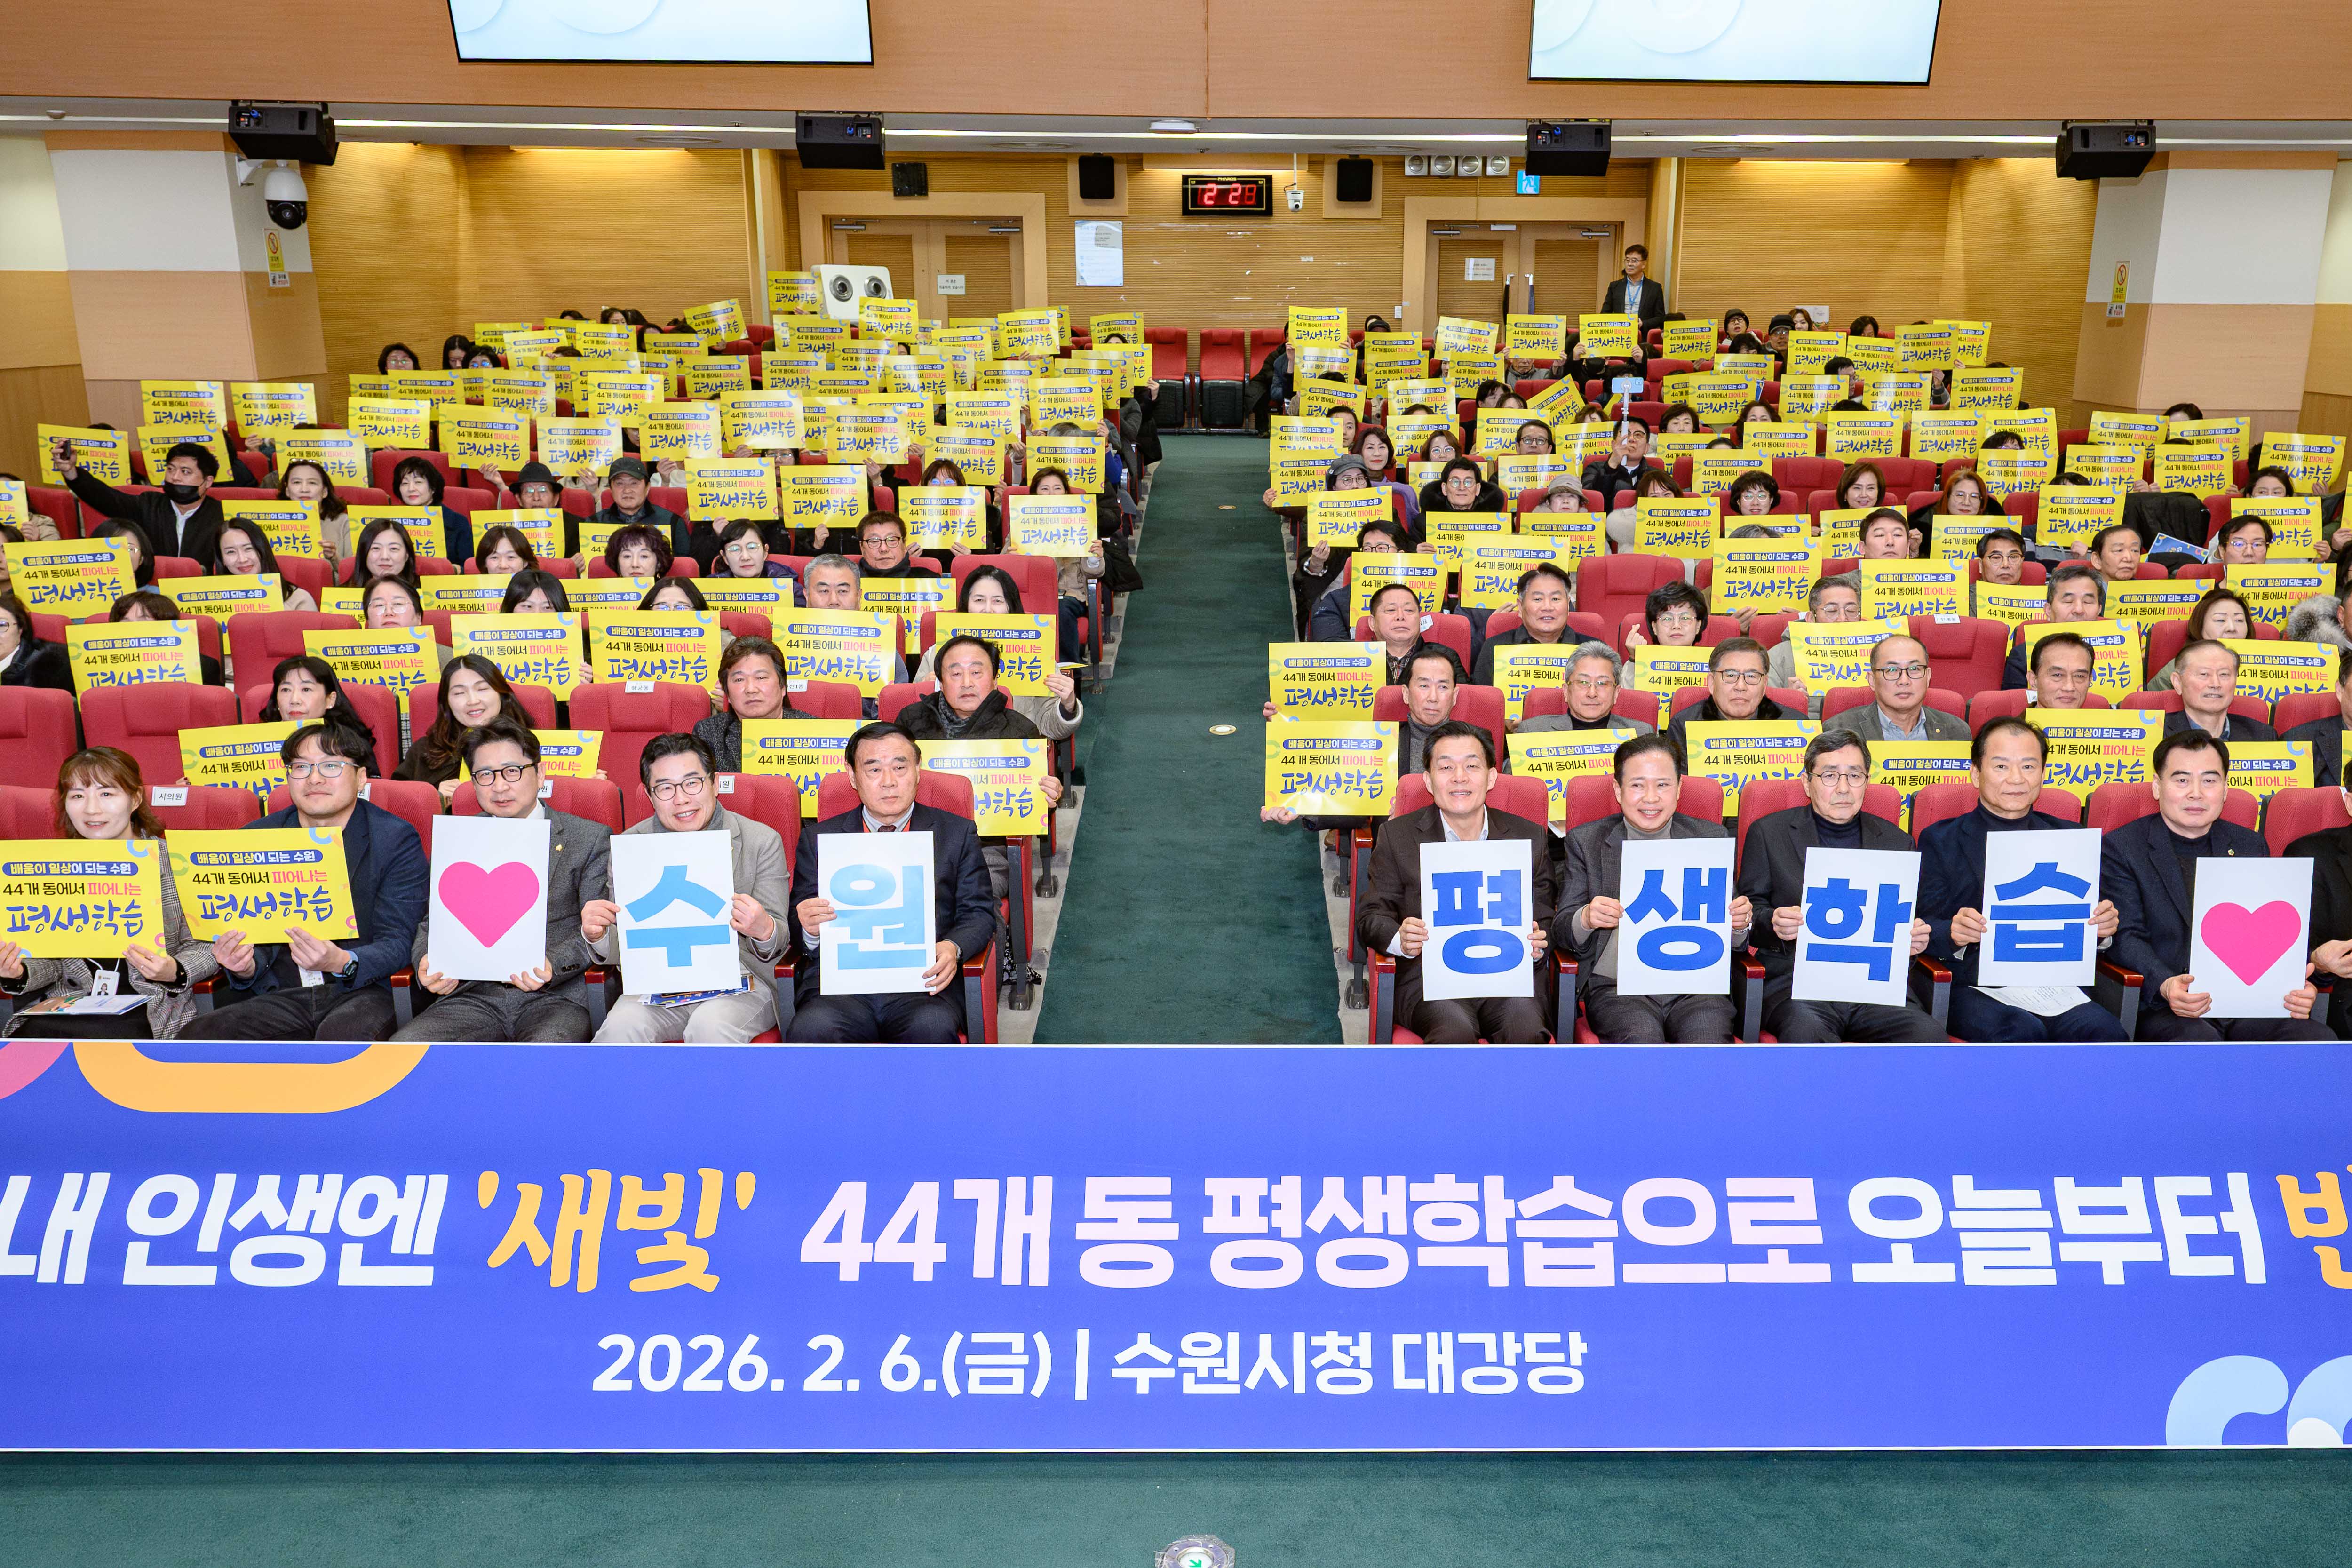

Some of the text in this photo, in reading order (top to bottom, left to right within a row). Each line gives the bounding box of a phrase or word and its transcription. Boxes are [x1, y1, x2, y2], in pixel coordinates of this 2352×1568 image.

[1296, 329, 1340, 341] 평생학습
[1587, 336, 1631, 348] 평생학습
[1513, 338, 1558, 350] 평생학습
[1902, 348, 1950, 362] 평생학습
[1039, 404, 1094, 420] 평생학습
[458, 443, 519, 461] 평생학습
[2165, 472, 2225, 489] 평생학습
[794, 498, 858, 516] 평생학습
[1644, 531, 1709, 548] 평생학습
[25, 566, 119, 579] 44개 동에서 피어나는
[1726, 565, 1810, 574] 44개 동에서 피어나는
[29, 579, 121, 604] 평생학습
[1725, 577, 1808, 600] 평생학습
[1875, 587, 1957, 596] 44개 동에서 피어나는
[612, 627, 699, 637] 배움이 일상이 되는 수원
[793, 624, 875, 637] 배움이 일상이 되는 수원
[606, 642, 707, 653] 44개 동에서 피어나는
[787, 639, 882, 652] 44개 동에서 피어나는
[608, 656, 707, 683] 평생학습
[787, 656, 880, 682] 평생학습
[1284, 672, 1373, 682] 44개 동에서 피어나는
[1285, 684, 1374, 708] 평생학습
[2048, 728, 2140, 738] 배움이 일상이 되는 수원
[1288, 740, 1376, 749] 배움이 일상이 되는 수원
[2068, 744, 2146, 756] 동에서 피어나는
[934, 758, 1025, 768] 배움이 일상이 되는 수원
[1281, 755, 1383, 766] 44개 동에서 피어나는
[991, 774, 1032, 785] 피어나는
[1281, 769, 1383, 799] 평생학습
[159, 792, 183, 801] 시의원
[197, 851, 316, 864] 배움이 일상이 되는 수원
[12, 862, 131, 875] 배움이 일상이 되는 수원
[192, 870, 327, 885] 44개 동에서 피어나는
[3, 883, 141, 896] 44개 동에서 피어나는
[198, 886, 333, 922] 평생학습
[7, 900, 143, 937] 평생학습
[625, 865, 730, 967] 수
[830, 865, 926, 970] 원
[1625, 867, 1727, 971] 생
[1990, 862, 2091, 962] 습
[1432, 870, 1524, 974] 평
[1806, 877, 1912, 982] 학
[0, 1173, 110, 1284] 내
[123, 1173, 448, 1287] 인생엔
[478, 1168, 755, 1293] '새빛'
[801, 1176, 1052, 1286] 44개
[1076, 1177, 1179, 1288] 동
[1203, 1174, 1831, 1289] 평생학습으로
[1848, 1173, 2266, 1285] 오늘부터
[593, 1331, 1051, 1398] 2026. 2. 6.(금)
[1112, 1331, 1587, 1394] 수원시청 대강당
